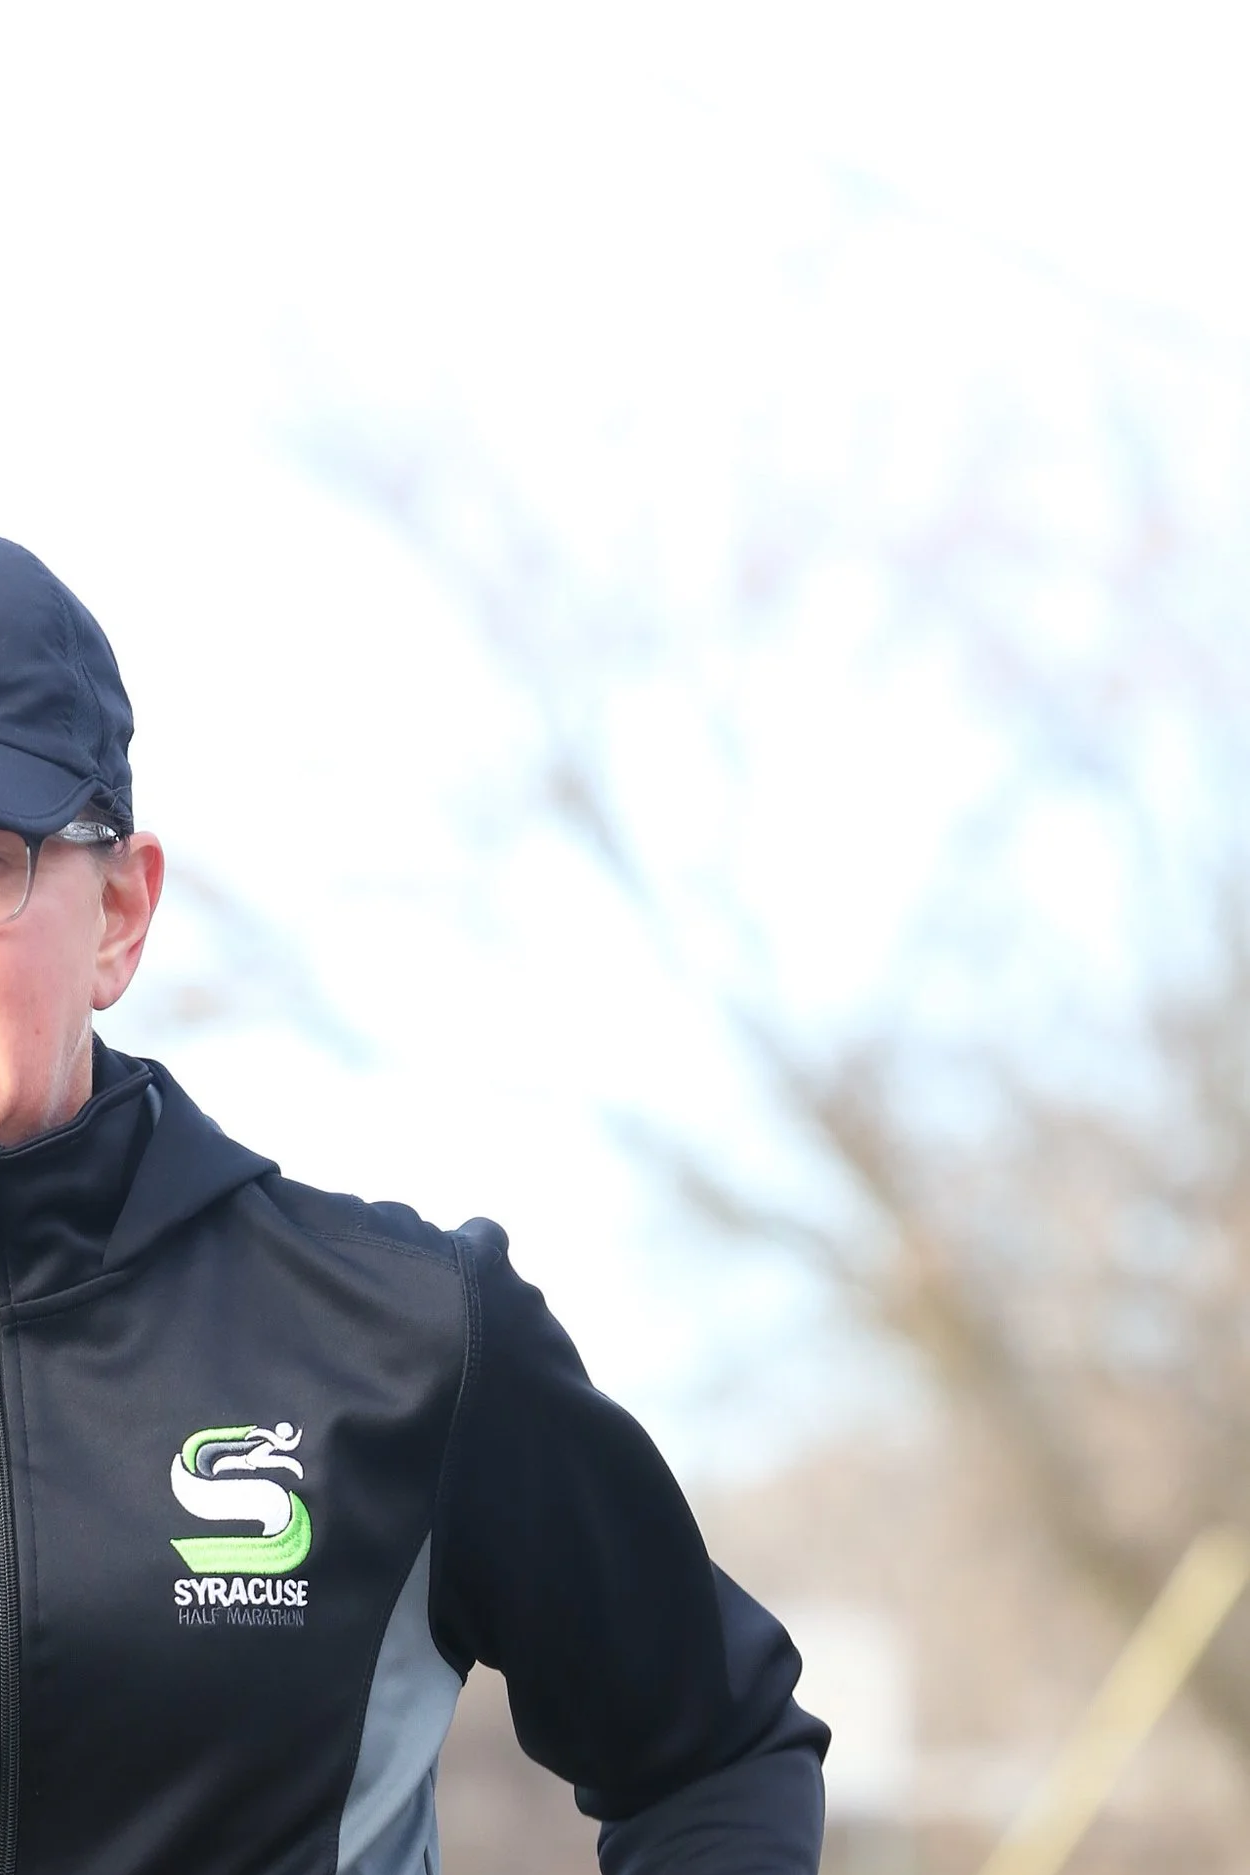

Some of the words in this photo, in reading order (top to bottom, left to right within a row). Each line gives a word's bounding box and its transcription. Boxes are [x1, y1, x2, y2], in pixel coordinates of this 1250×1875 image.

[173, 1577, 309, 1607] SYRACUSE
[178, 1607, 221, 1625] HALF
[226, 1607, 305, 1627] MARATHON
